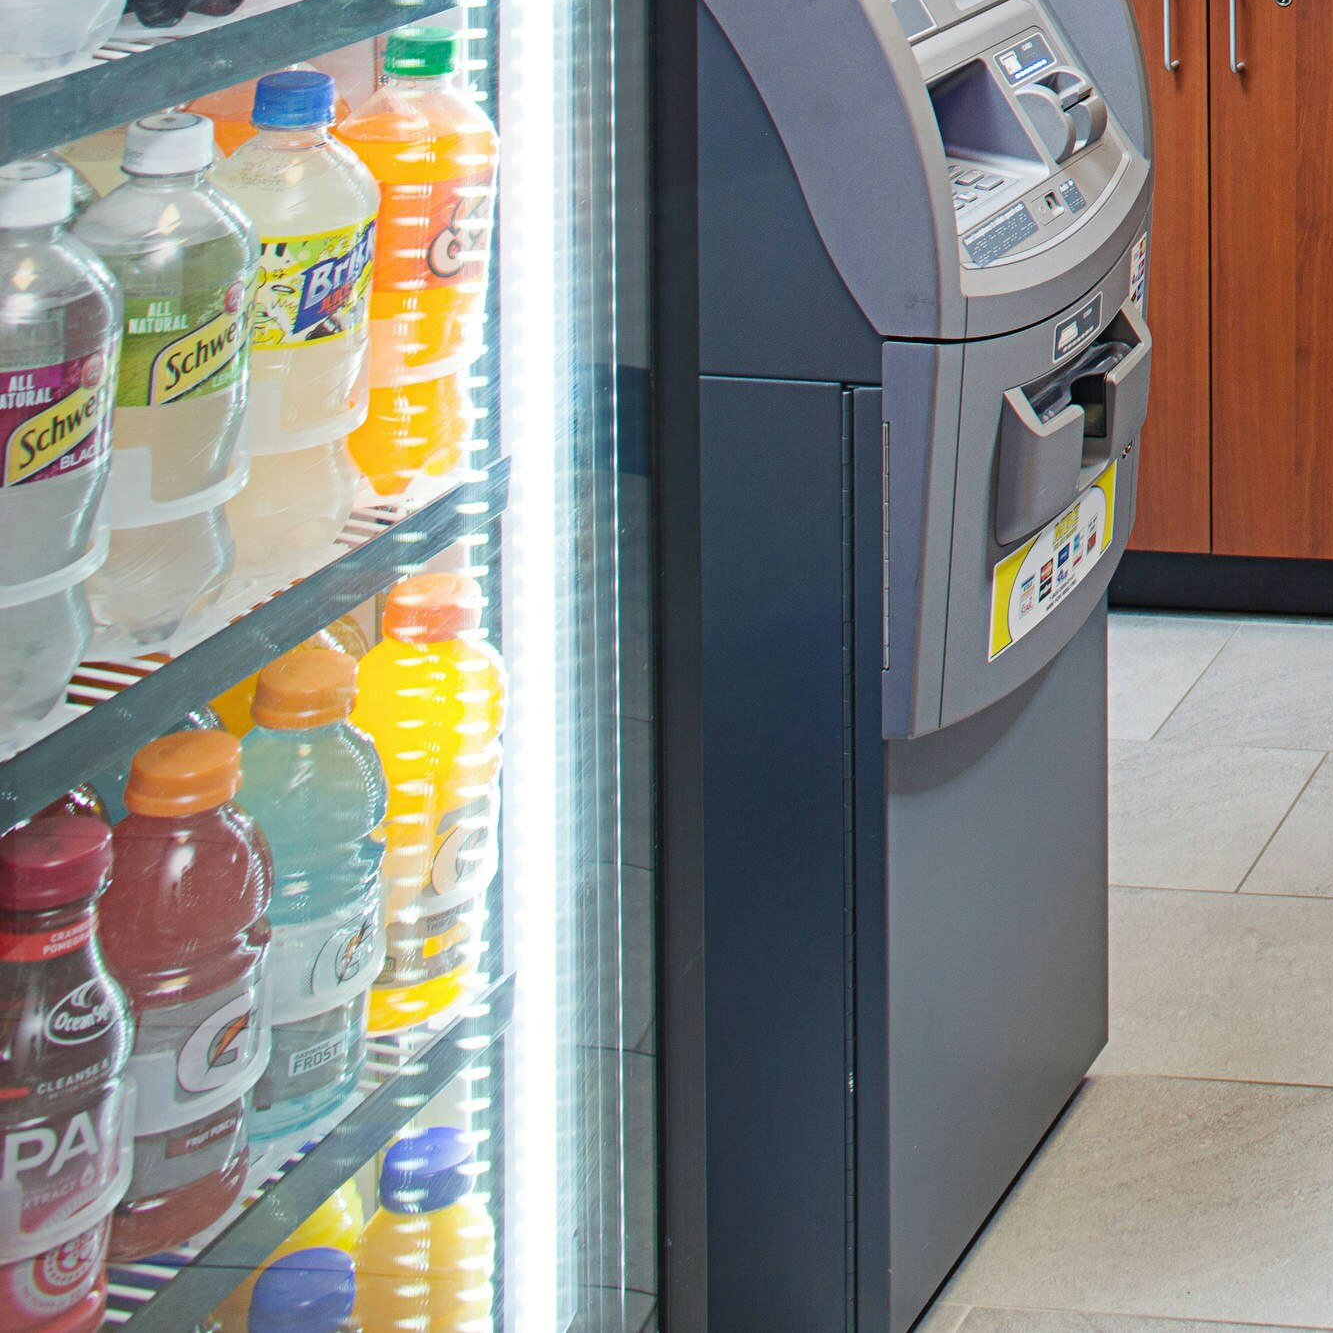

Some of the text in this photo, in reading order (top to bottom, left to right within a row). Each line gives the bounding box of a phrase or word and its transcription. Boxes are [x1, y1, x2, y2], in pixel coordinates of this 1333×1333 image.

[147, 300, 173, 318] ALL
[128, 313, 191, 335] NATURAL
[8, 373, 36, 393] ALL
[60, 443, 98, 470] BLAC
[53, 1011, 95, 1033] Ocean
[293, 1042, 342, 1074] FROST
